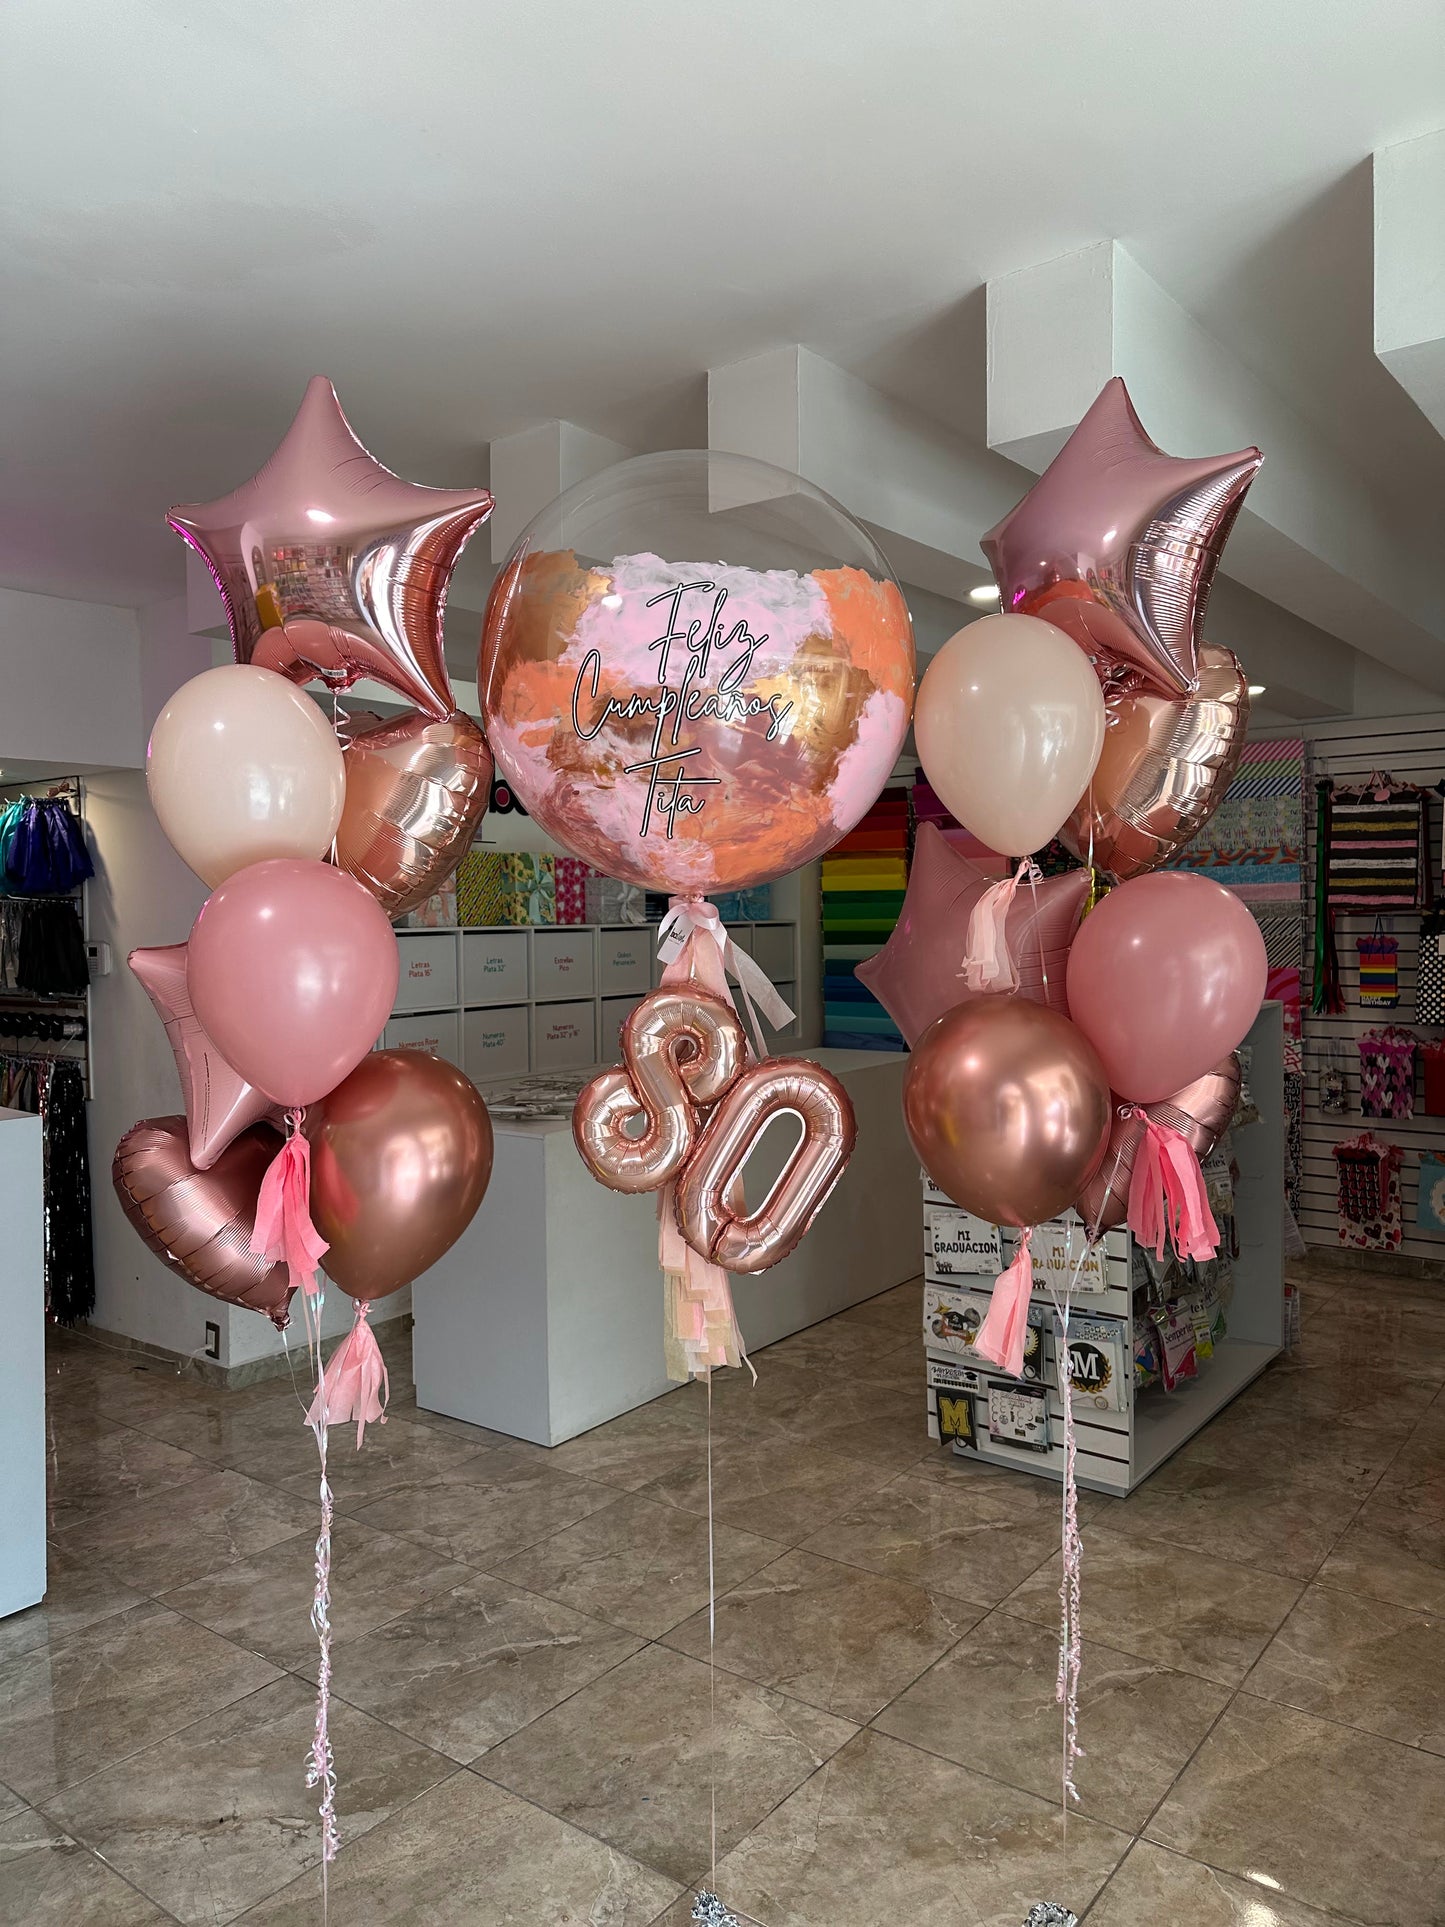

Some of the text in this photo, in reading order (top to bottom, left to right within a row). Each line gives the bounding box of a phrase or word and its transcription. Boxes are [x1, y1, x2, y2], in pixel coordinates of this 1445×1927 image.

[646, 581, 769, 695] Feliz
[572, 649, 794, 759] Cumpleaños
[624, 748, 721, 839] Tita
[411, 961, 430, 969] Letras
[486, 957, 503, 965] Letras
[408, 970, 423, 978] Plata
[483, 965, 496, 973] Plata
[957, 1230, 971, 1241] MI
[934, 1242, 998, 1254] GRADUACION
[1052, 1246, 1065, 1258] MI
[1071, 1351, 1100, 1380] M
[939, 1397, 971, 1436] M
